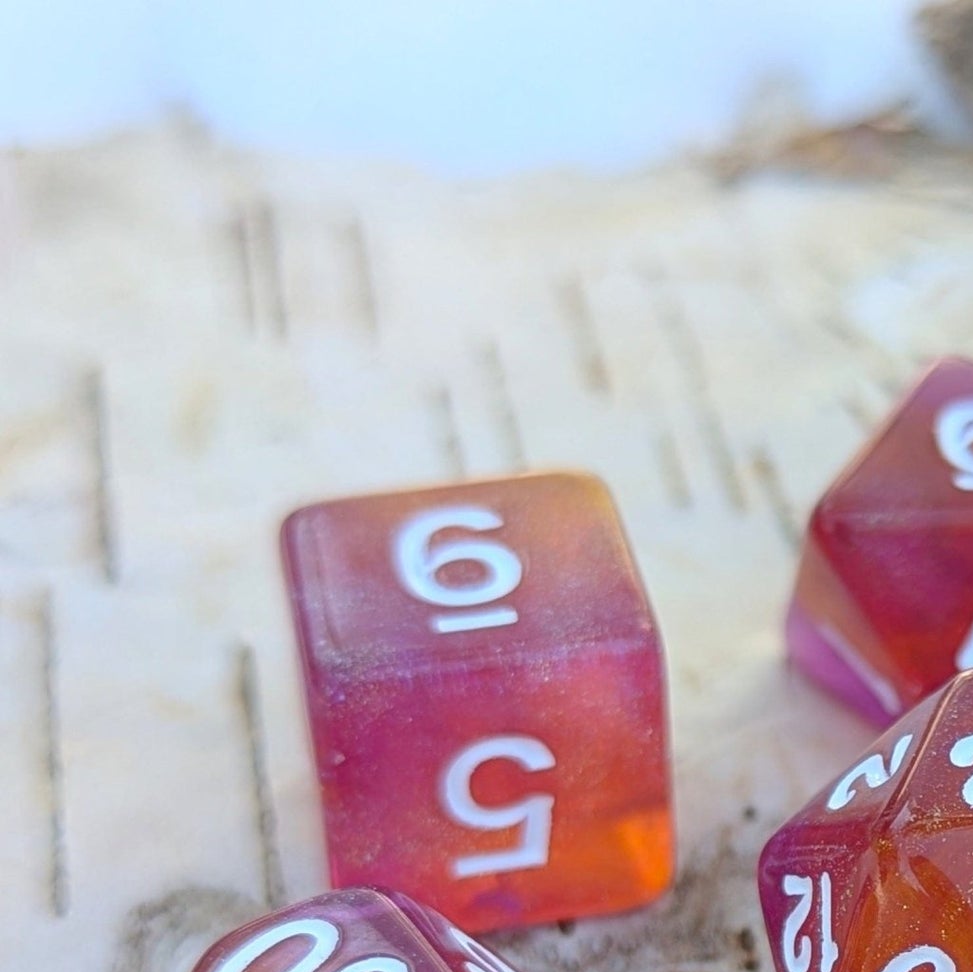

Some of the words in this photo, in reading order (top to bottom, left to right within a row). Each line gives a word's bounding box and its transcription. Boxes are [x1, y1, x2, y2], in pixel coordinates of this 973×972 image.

[395, 505, 522, 633] 6
[439, 735, 557, 879] 5
[827, 734, 913, 810] 2
